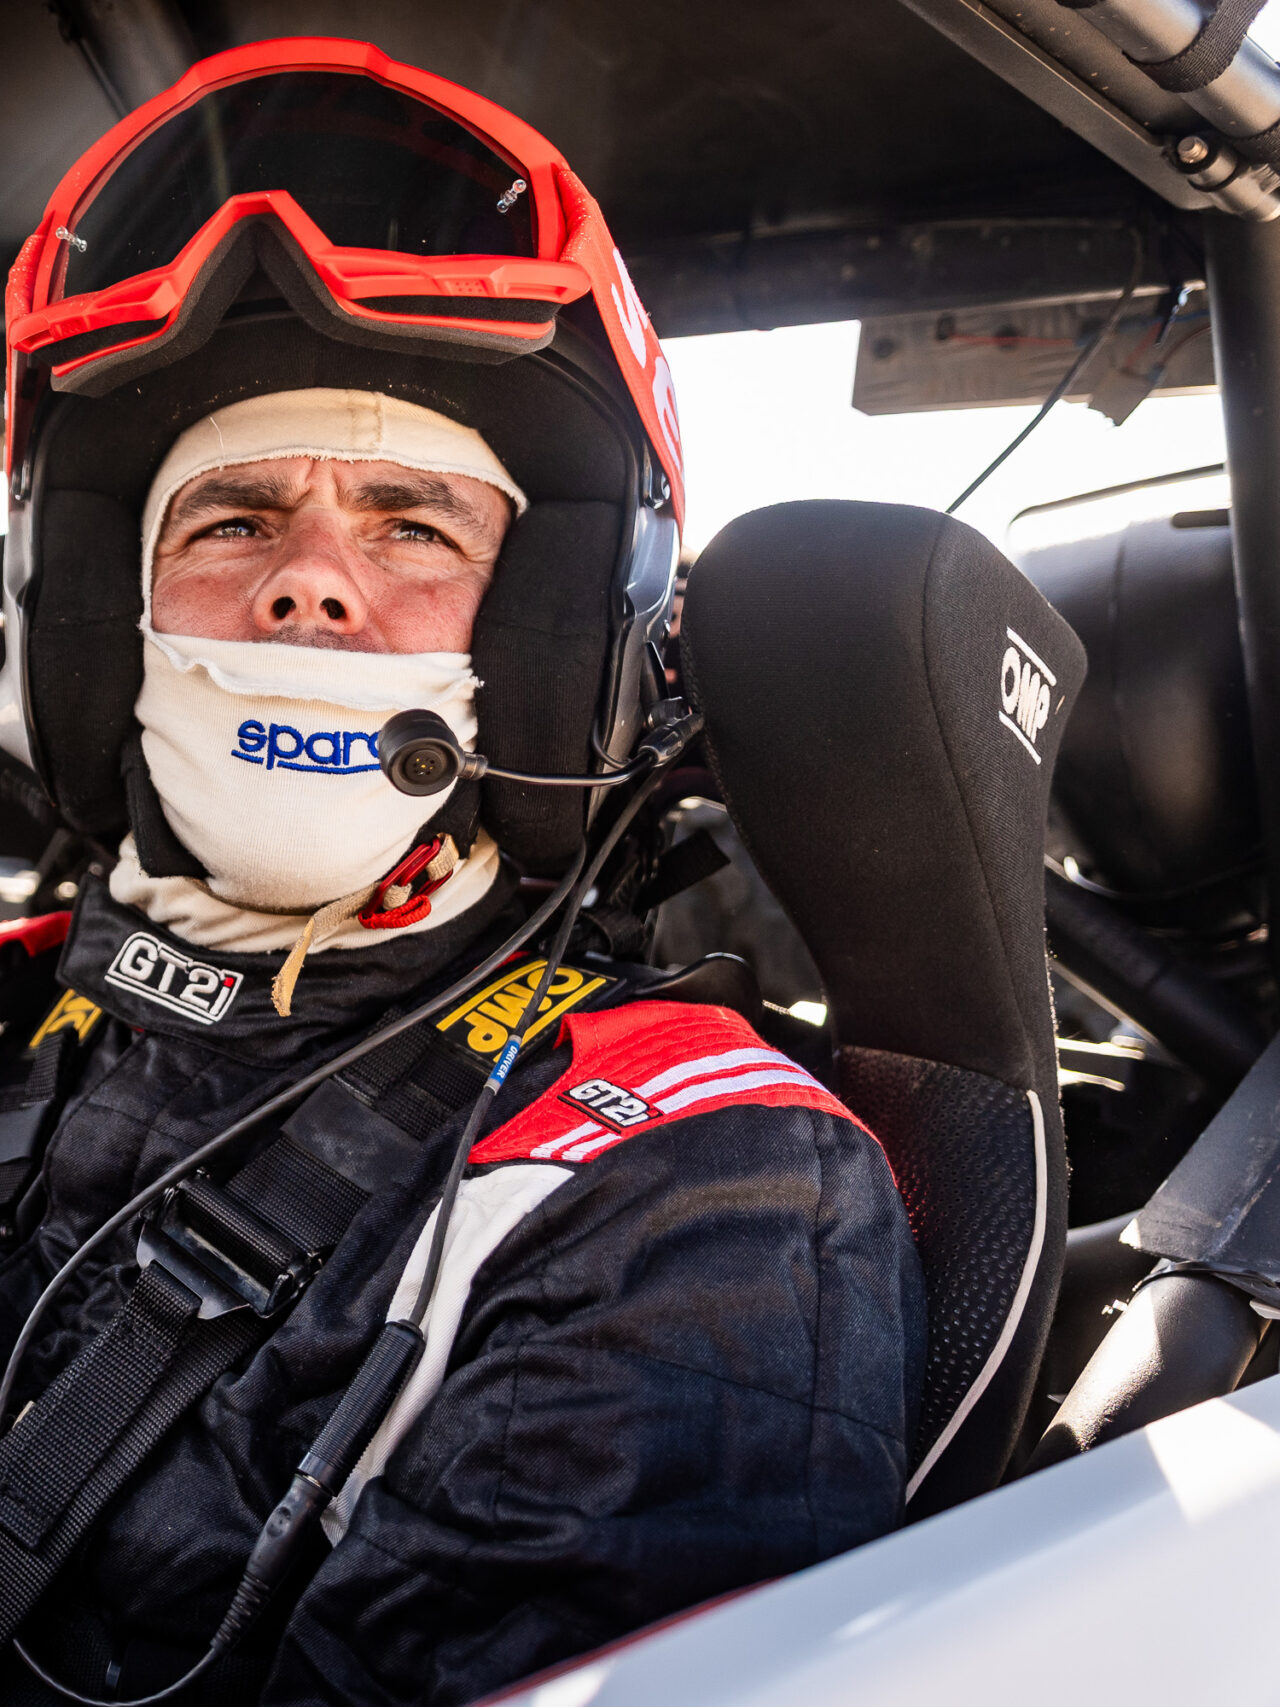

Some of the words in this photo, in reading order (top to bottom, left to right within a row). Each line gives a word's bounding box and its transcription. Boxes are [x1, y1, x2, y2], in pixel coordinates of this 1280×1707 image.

[1000, 645, 1051, 744] OMP
[237, 719, 382, 771] spar
[119, 937, 236, 1017] GT2i
[463, 966, 584, 1054] OMP
[496, 1045, 520, 1080] DRIVER
[569, 1078, 659, 1127] GT2i
